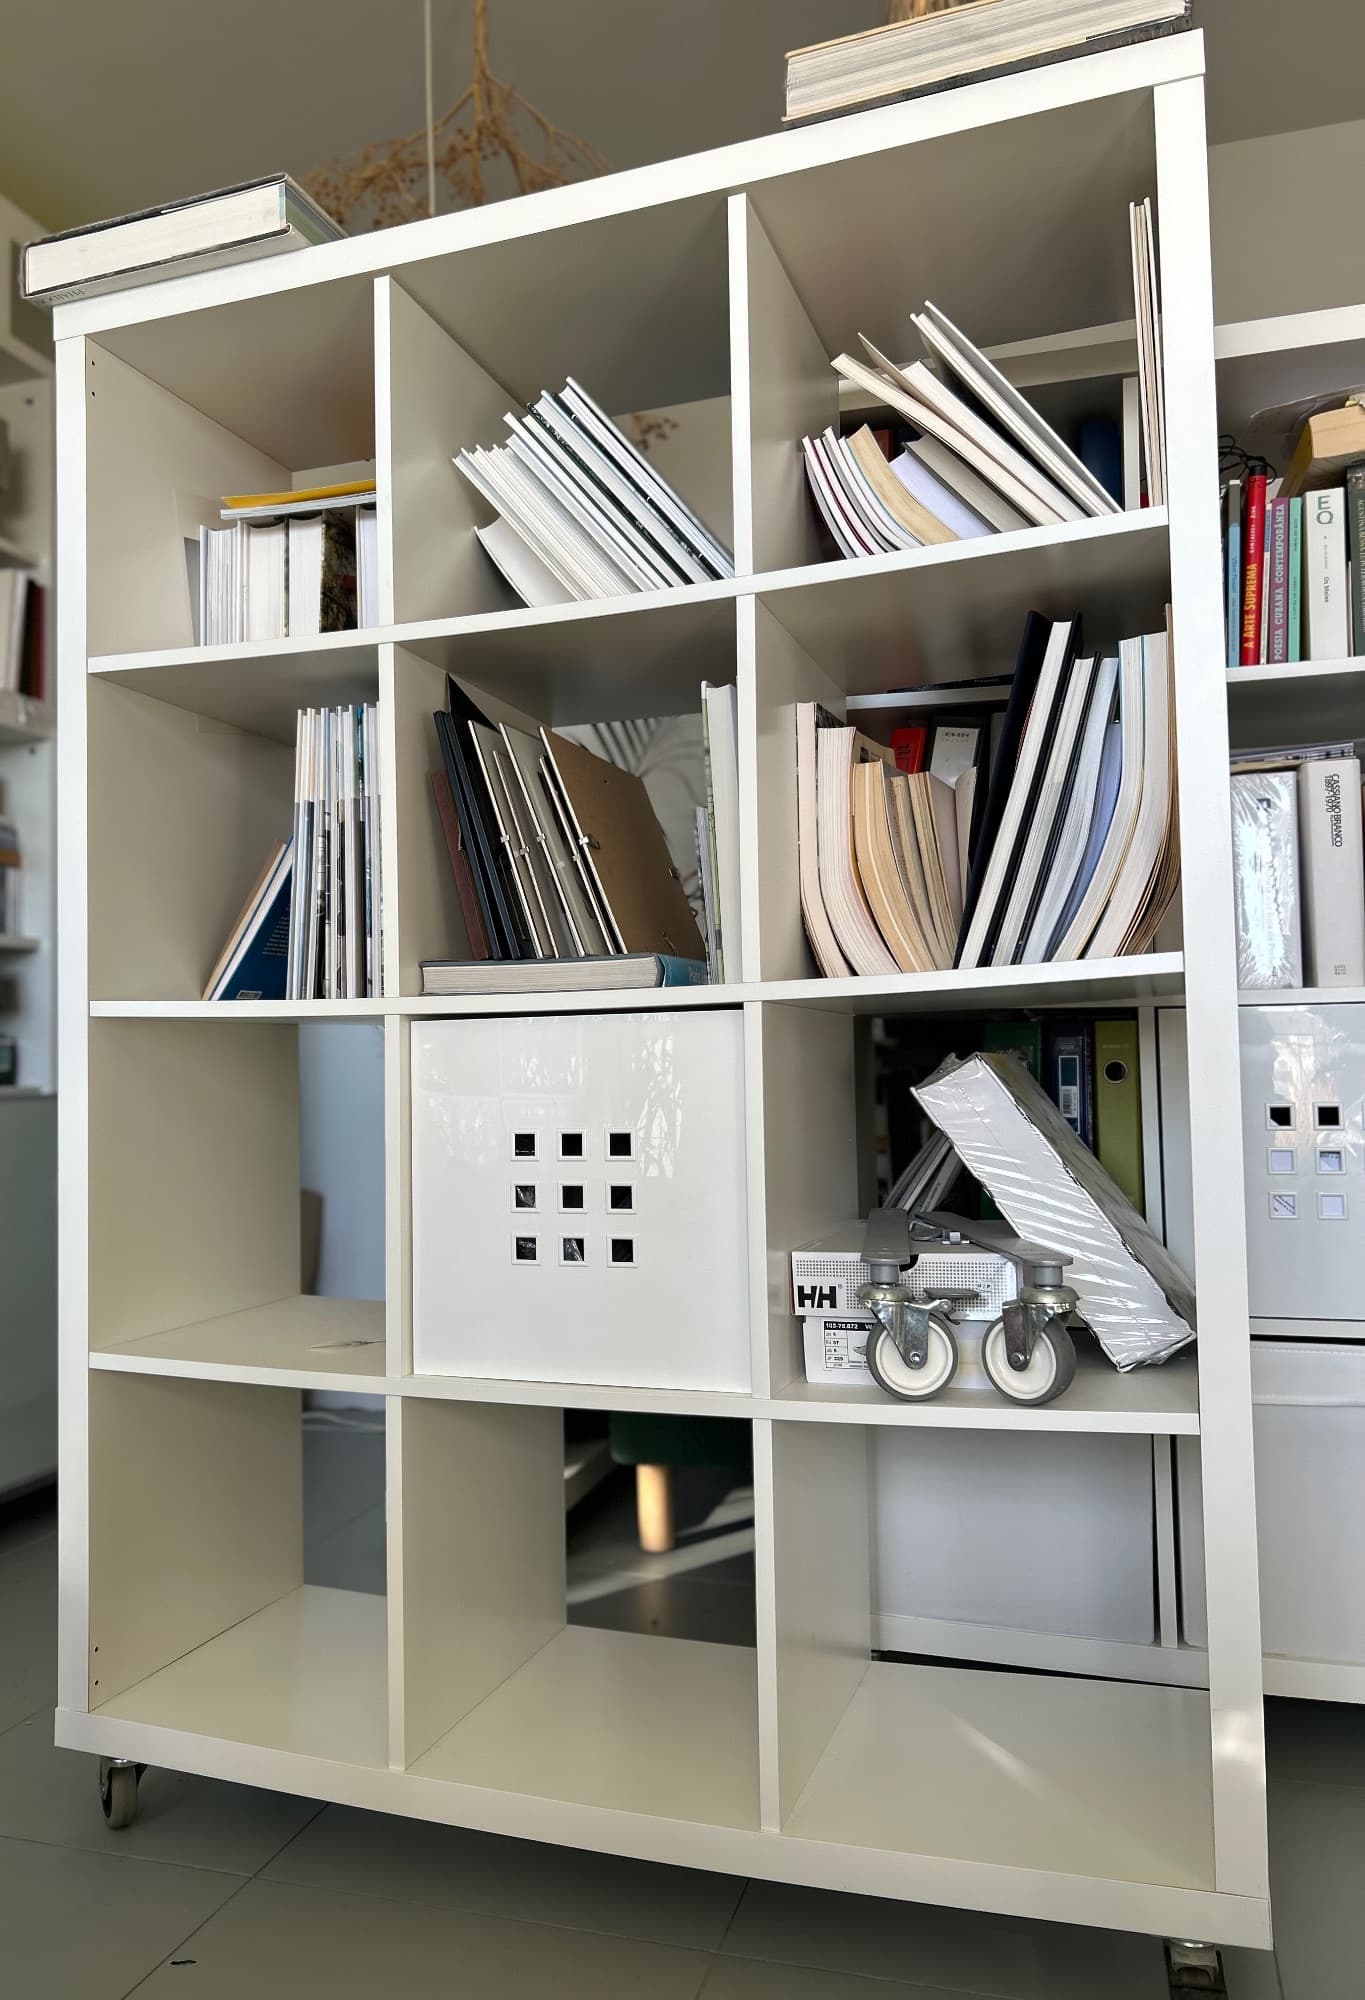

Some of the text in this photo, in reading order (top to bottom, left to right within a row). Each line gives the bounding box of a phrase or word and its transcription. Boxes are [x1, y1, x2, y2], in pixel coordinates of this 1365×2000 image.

[1274, 504, 1285, 660] POESIA CUBANA CONTEMPORÂNEA
[1243, 563, 1257, 649] A ARTE SUPREMA
[1324, 774, 1334, 813] 1897-1970
[1332, 773, 1341, 814] CASSIANO
[1333, 814, 1342, 847] BRANCO
